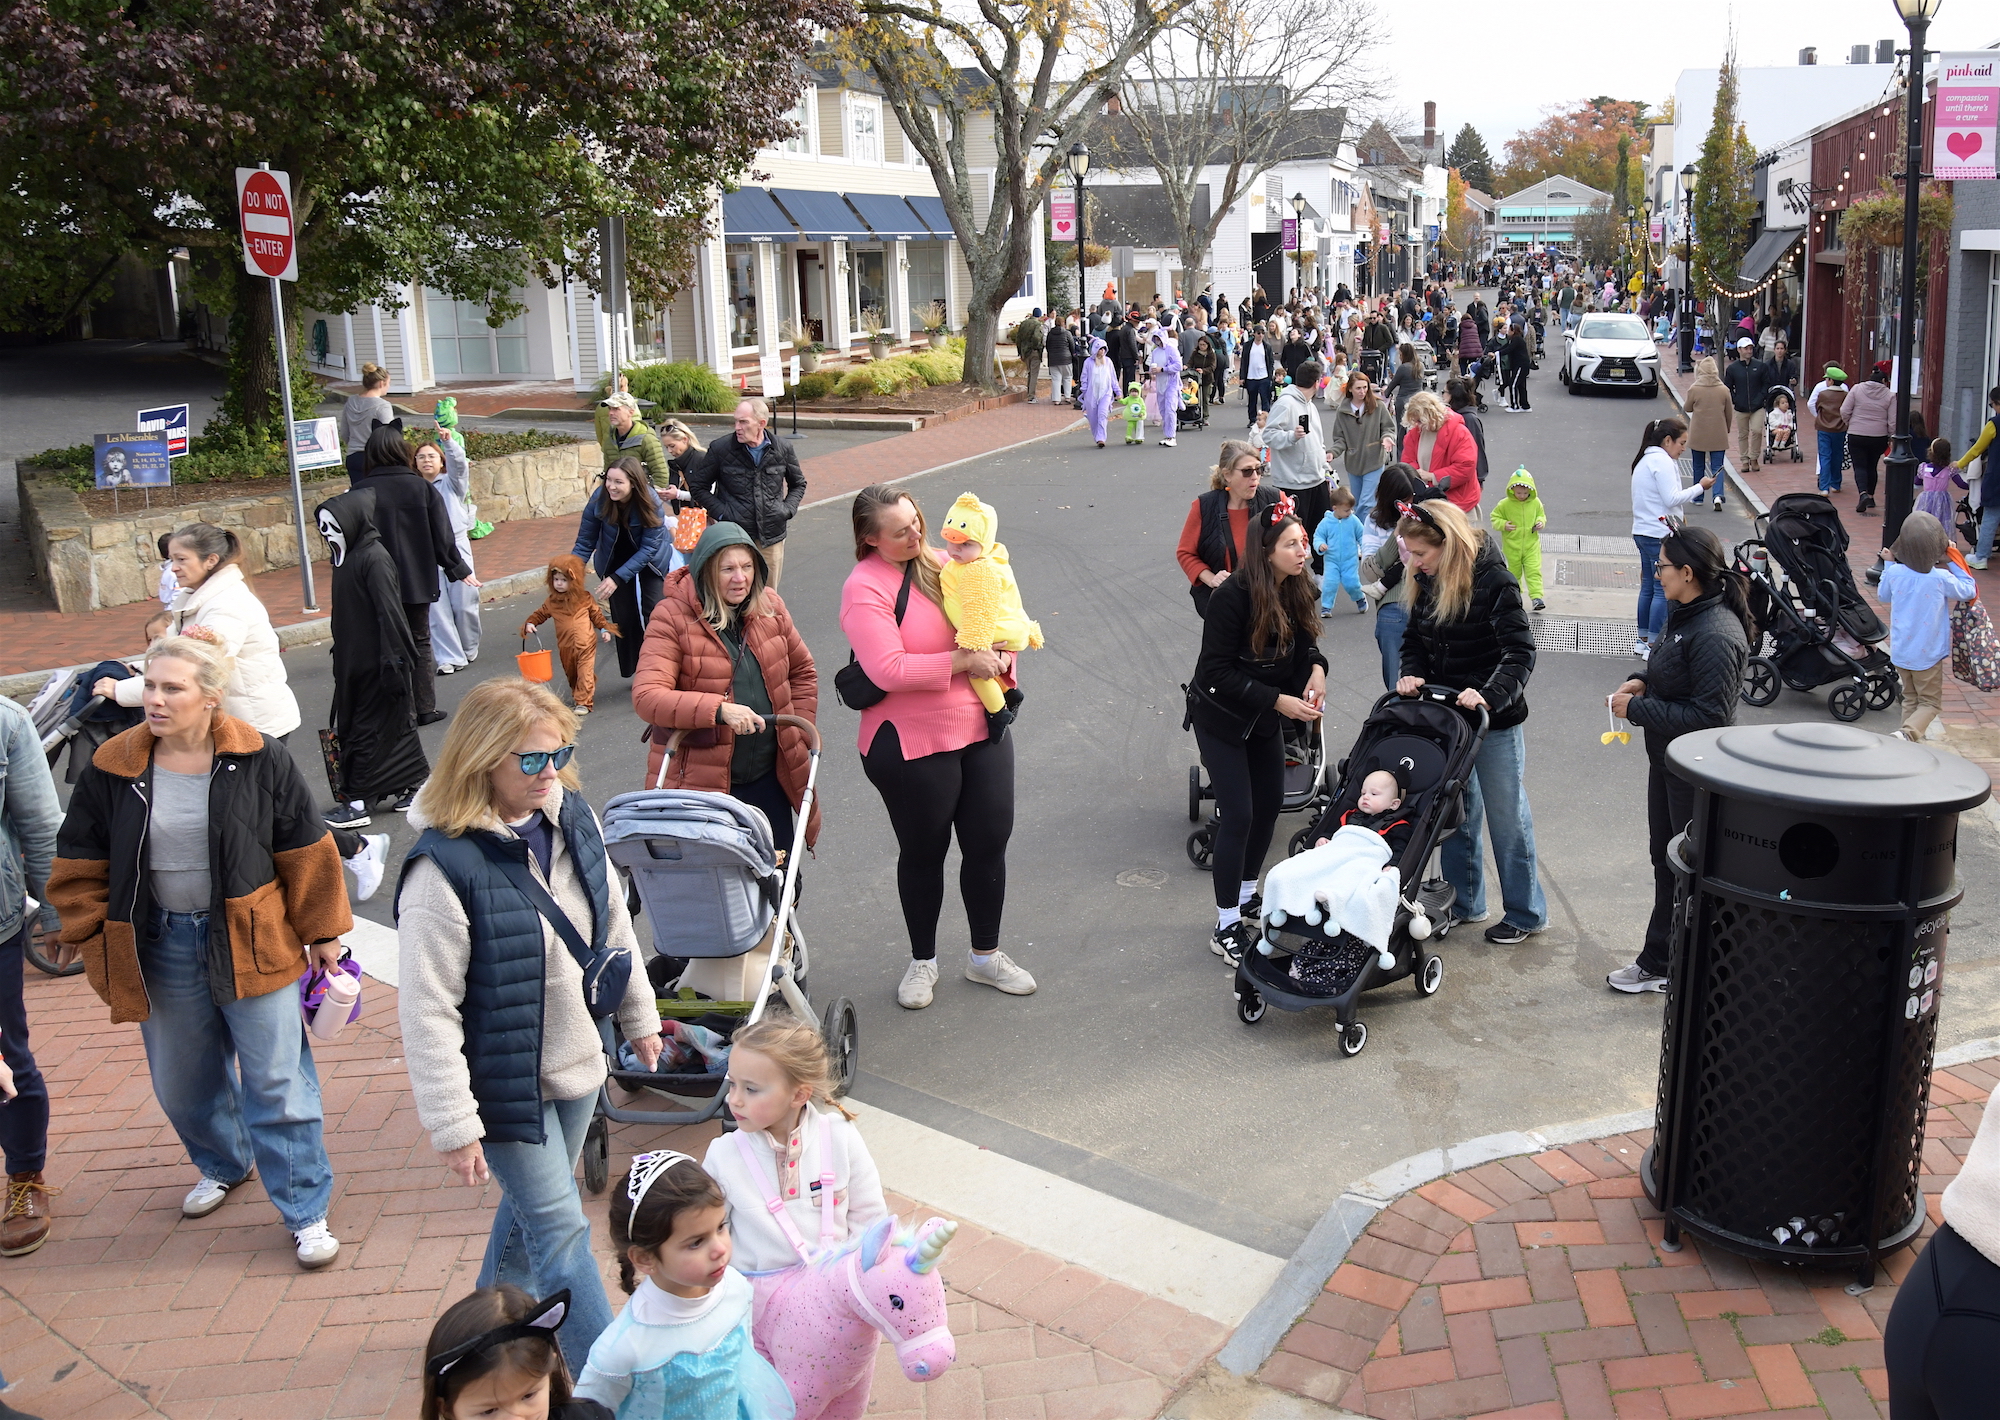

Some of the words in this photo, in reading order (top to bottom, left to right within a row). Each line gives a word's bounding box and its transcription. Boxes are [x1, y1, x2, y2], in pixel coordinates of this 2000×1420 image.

[1946, 63, 1973, 80] pink
[1974, 63, 1993, 77] aid
[1946, 94, 1989, 103] compassion
[1964, 104, 1988, 112] there's
[246, 191, 260, 208] DO
[264, 193, 283, 210] NOT
[254, 238, 284, 257] ENTER
[140, 418, 165, 432] DAVID
[106, 434, 119, 443] Les
[163, 426, 187, 440] VANS
[1724, 827, 1777, 850] BOTTLES
[1861, 850, 1896, 860] CANS
[1920, 914, 1947, 934] ecycle
